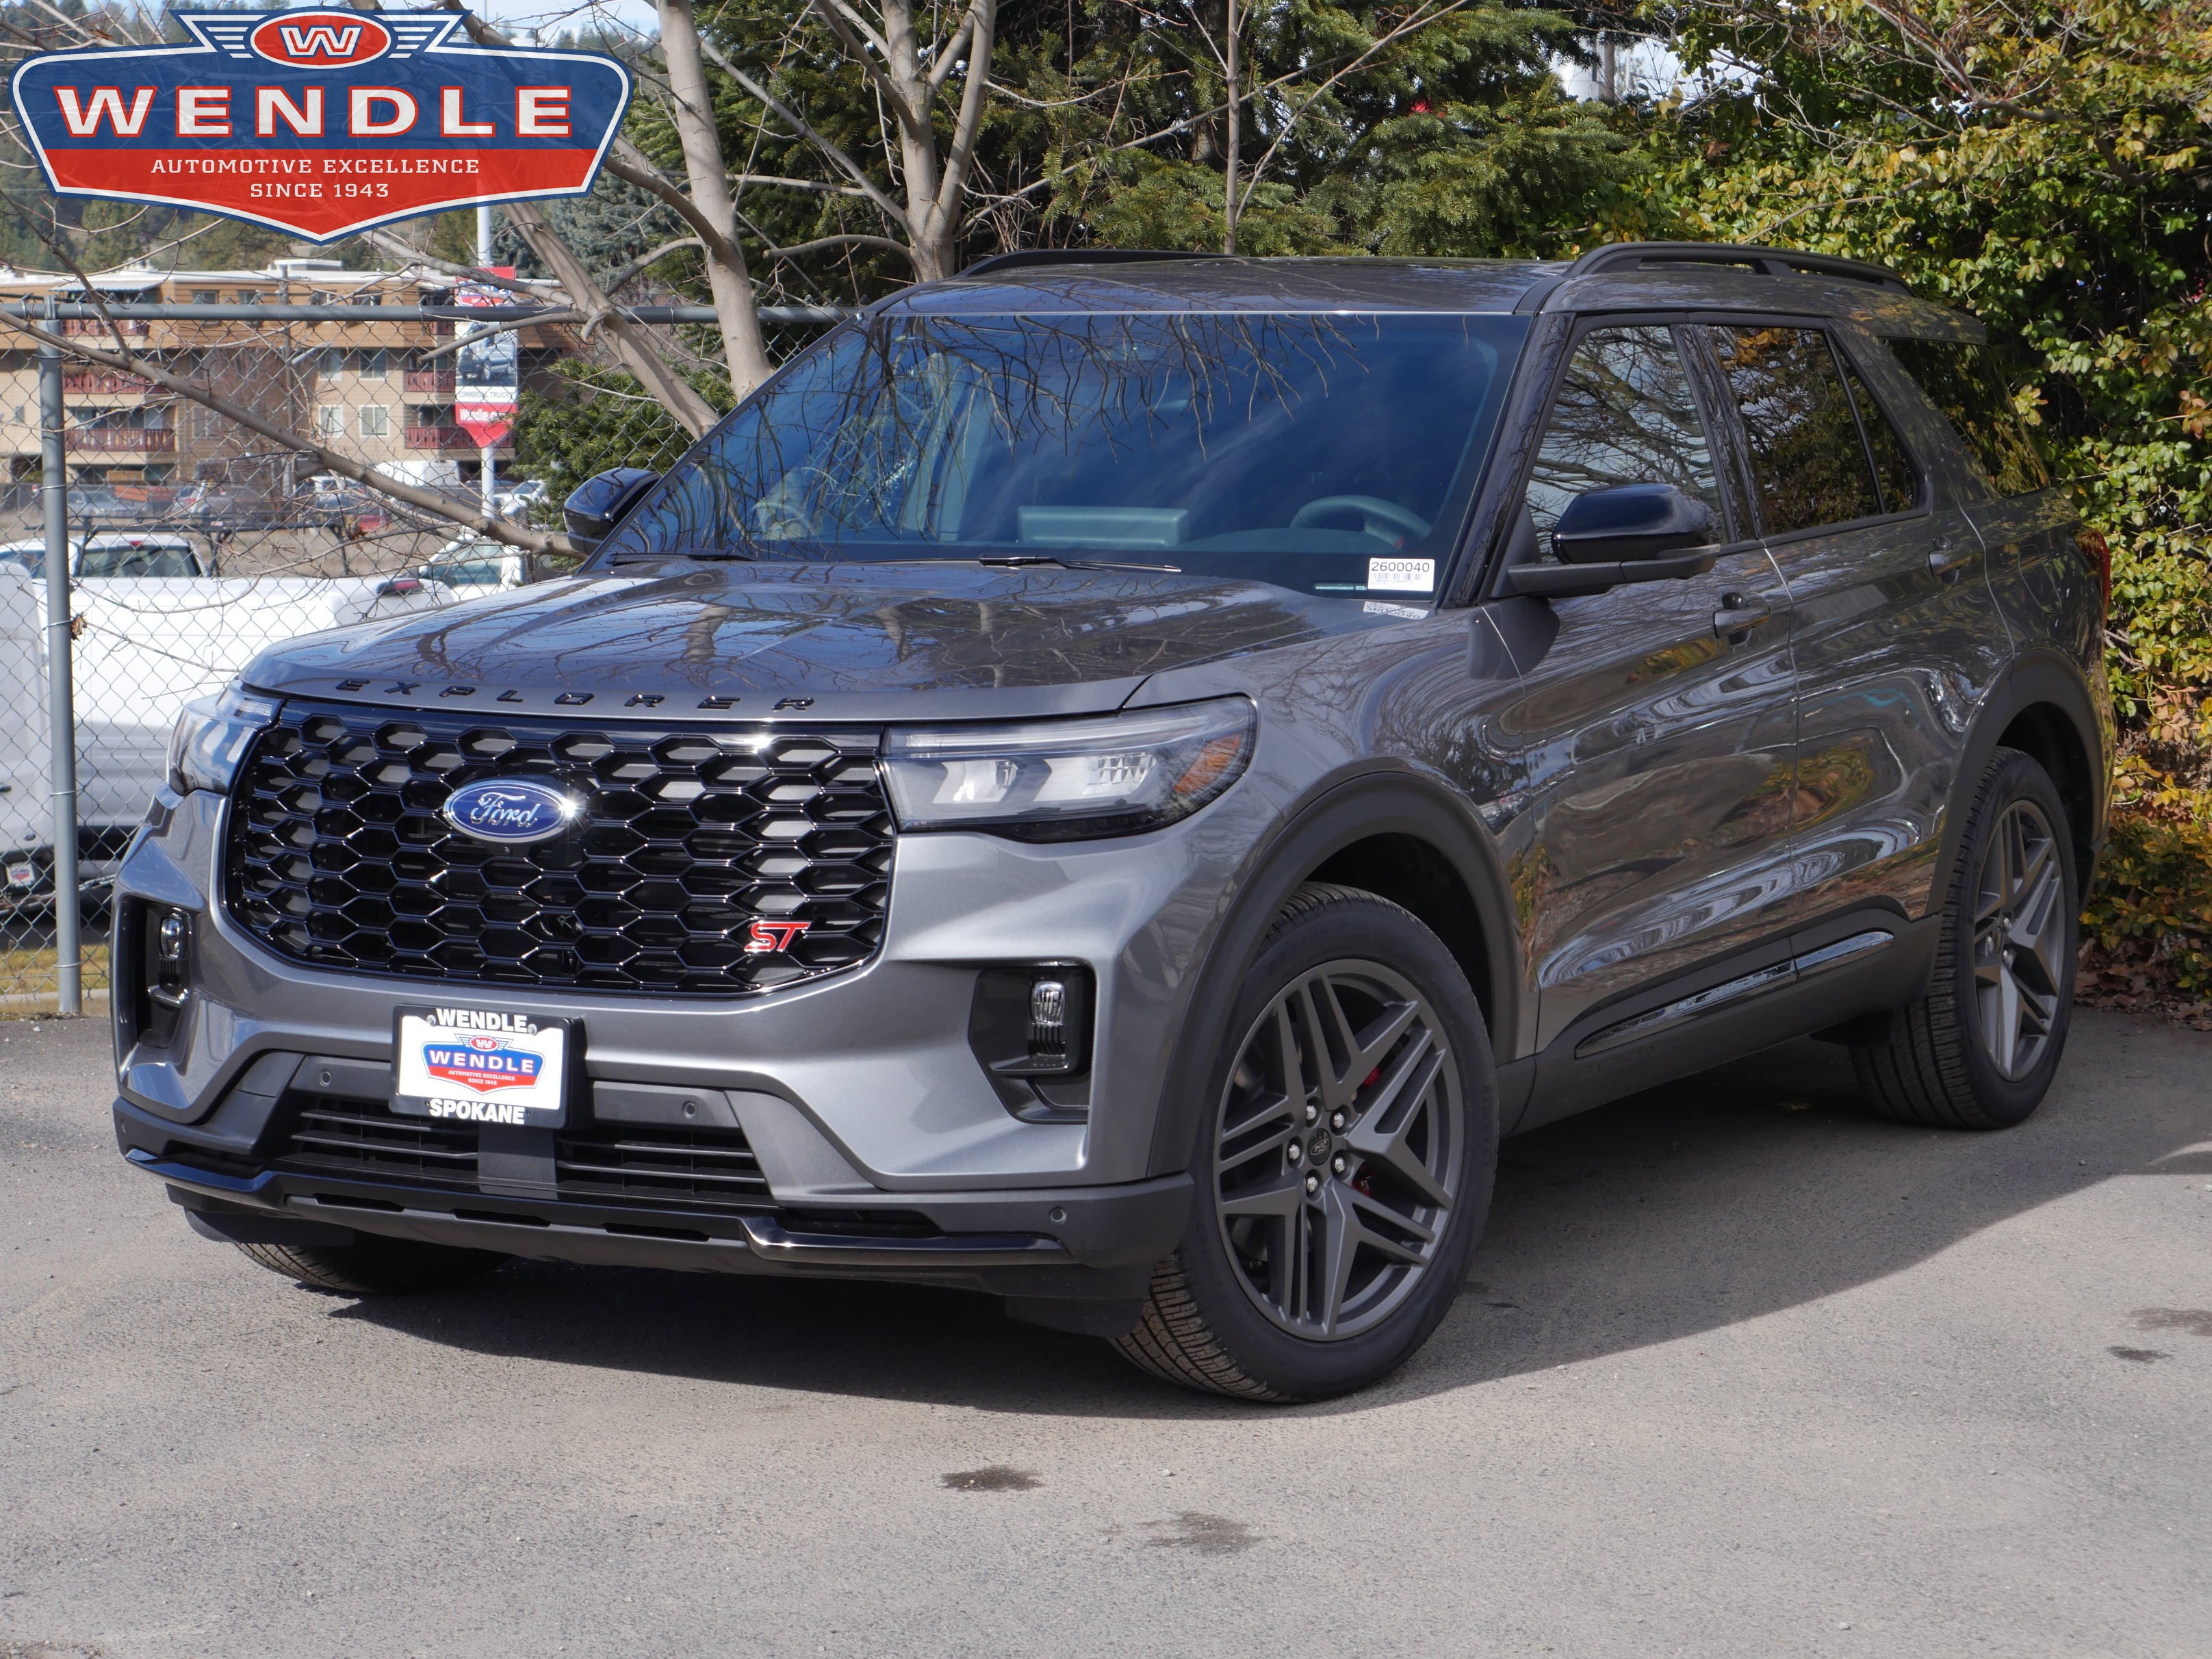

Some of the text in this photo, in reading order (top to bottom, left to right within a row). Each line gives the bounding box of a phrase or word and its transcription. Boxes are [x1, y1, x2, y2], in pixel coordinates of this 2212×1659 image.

[1371, 561, 1430, 573] 2600040
[335, 678, 814, 711] EXPLORER
[470, 791, 541, 828] Ford
[744, 921, 812, 953] ST
[435, 1008, 528, 1034] WENDLE
[428, 1050, 535, 1074] WENDLE
[448, 1069, 515, 1081] AUTOMOTIVE EXCELLENCE
[428, 1097, 526, 1125] SPOKANE
